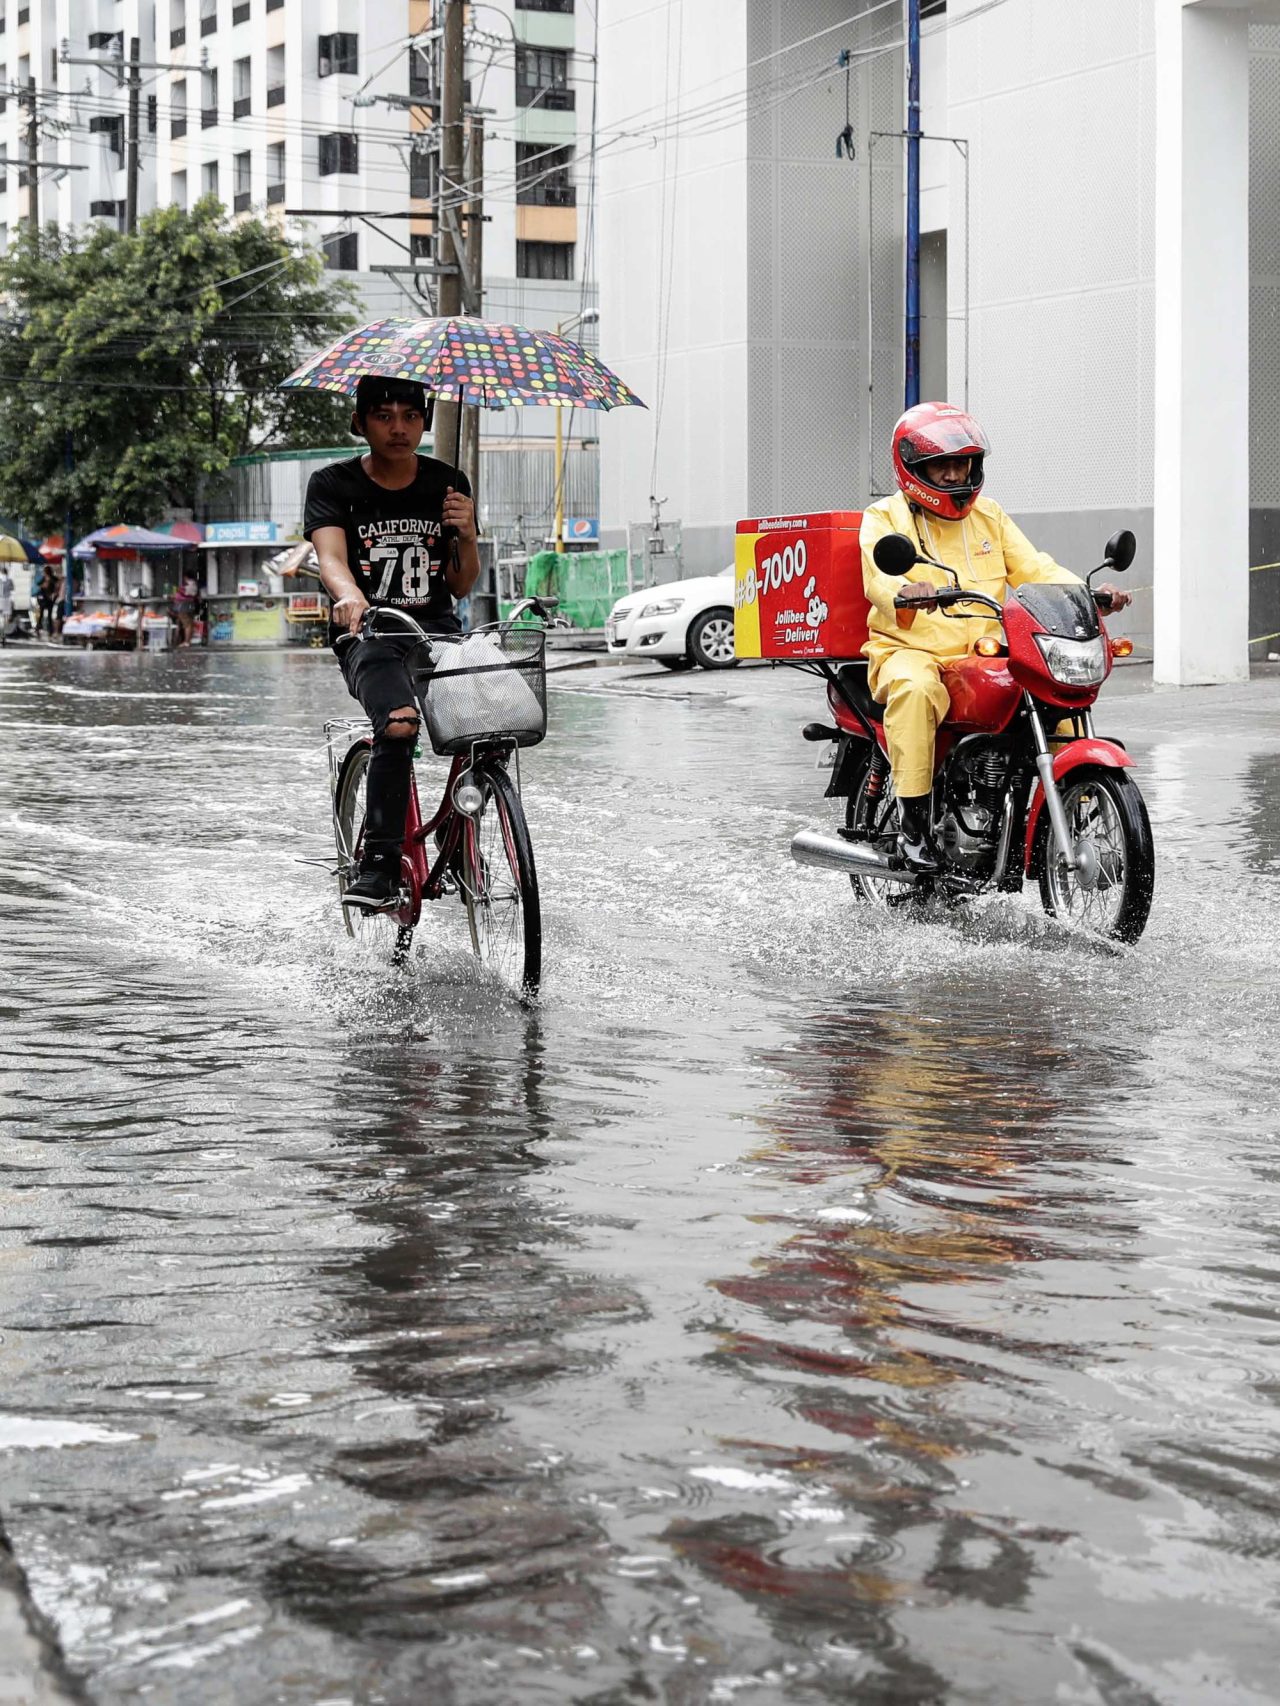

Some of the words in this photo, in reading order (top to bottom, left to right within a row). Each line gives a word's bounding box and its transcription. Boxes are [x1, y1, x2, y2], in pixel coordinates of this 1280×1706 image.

[358, 518, 442, 539] CALIFORNIA
[370, 546, 430, 598] 78
[735, 539, 807, 609] #8-7000
[775, 609, 805, 626] Jollibee
[785, 626, 819, 644] Delivery
